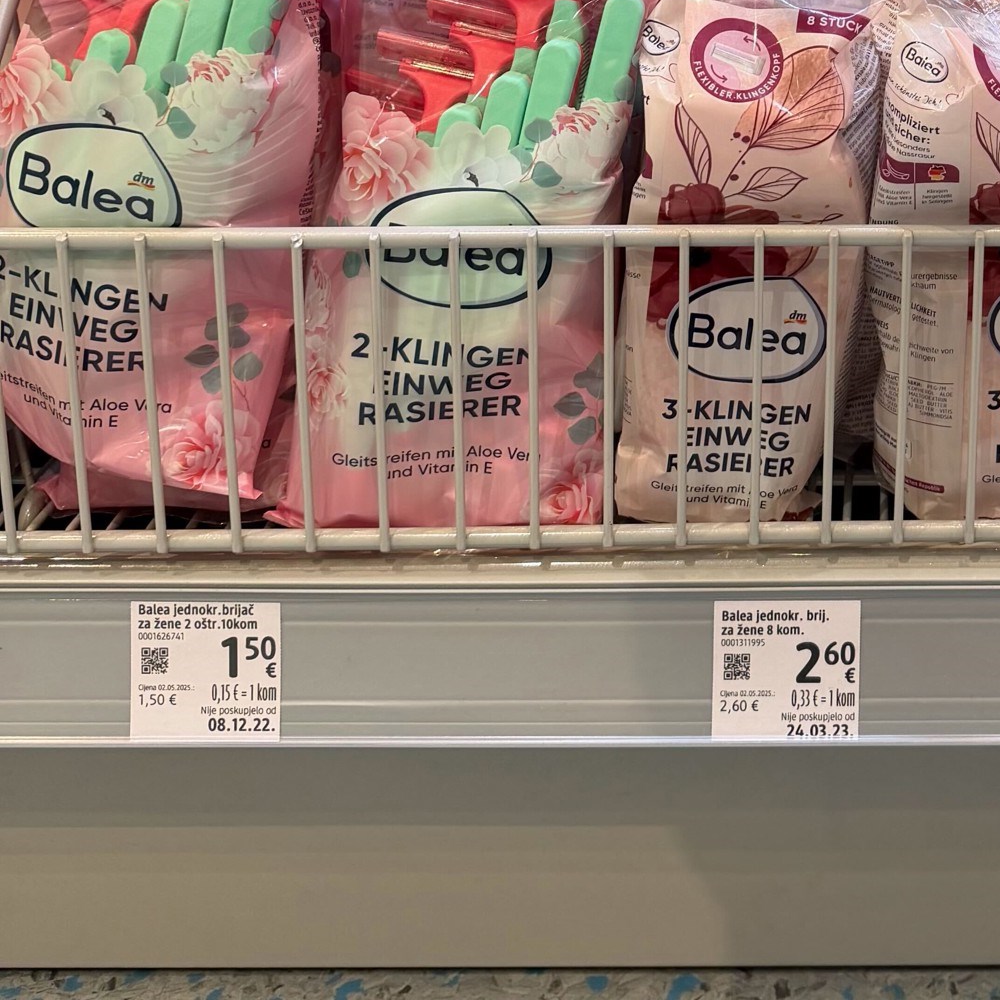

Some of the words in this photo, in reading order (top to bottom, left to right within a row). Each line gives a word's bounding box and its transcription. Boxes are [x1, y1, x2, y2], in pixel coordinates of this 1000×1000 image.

[692, 59, 734, 100] FLEXIBLER
[736, 52, 782, 101] KLINGENKOPF
[18, 151, 155, 222] Balea
[688, 312, 808, 356] Balea
[23, 393, 48, 411] und
[108, 415, 118, 428] E
[90, 399, 129, 411] Aloe
[358, 394, 522, 426] RASIERER
[332, 448, 432, 467] Gleitsreifen
[466, 445, 503, 459] Aloe
[484, 461, 493, 475] E
[778, 484, 799, 497] Vera
[138, 604, 170, 616] Balea
[173, 603, 254, 618] jednokr.brijač
[721, 610, 753, 621] Balea
[756, 610, 803, 623] jednokr.
[806, 609, 830, 623] brij.
[138, 620, 151, 629] za
[154, 617, 181, 630] žene
[184, 619, 191, 629] 2
[194, 618, 258, 630] oštr.10kom
[721, 626, 733, 636] za
[737, 624, 764, 636] žene
[767, 626, 774, 636] 8
[776, 624, 805, 636] kom.
[138, 632, 184, 640] 0001626741
[721, 638, 765, 646] 0001311995
[138, 694, 165, 707] 1,50
[211, 683, 230, 704] 0,15
[257, 683, 277, 701] kom
[791, 689, 810, 710] 0,33
[836, 688, 855, 707] kom
[200, 706, 217, 716] Nije
[219, 706, 264, 716] poskupjelo
[266, 706, 276, 715] od
[720, 699, 747, 713] 2,60
[781, 712, 796, 722] Nije
[798, 712, 842, 722] poskupjelo
[844, 712, 855, 720] od
[208, 717, 276, 732] 08.12.22.
[786, 724, 854, 736] 24.03.23.
